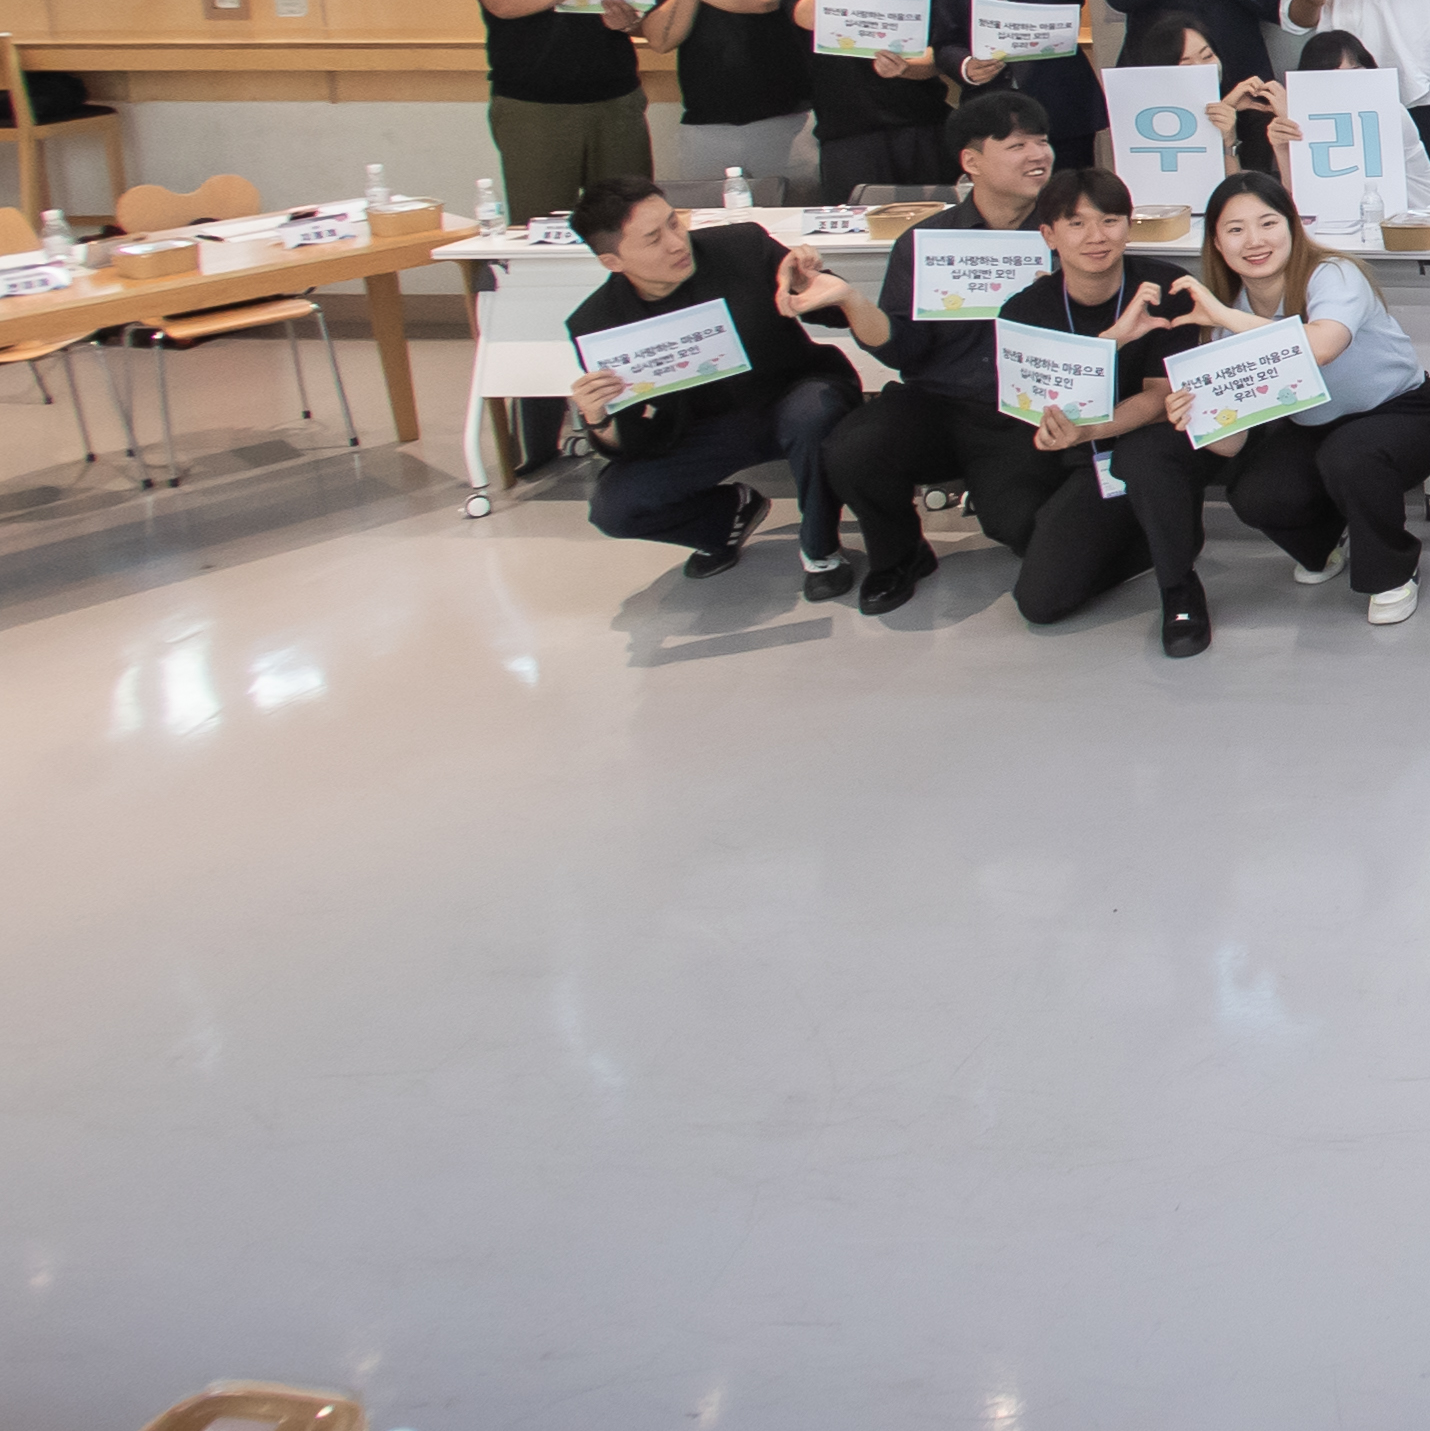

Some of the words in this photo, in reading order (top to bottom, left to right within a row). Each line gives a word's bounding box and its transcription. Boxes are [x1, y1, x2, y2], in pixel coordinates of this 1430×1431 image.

[1130, 106, 1207, 172] 우
[1308, 110, 1383, 178] 리
[926, 256, 954, 266] 청년을
[959, 256, 998, 266] 사랑하는
[1003, 256, 1042, 266] 마음으로
[952, 269, 991, 279] 십시일반
[995, 269, 1015, 279] 모인
[968, 283, 988, 292] 우리
[635, 342, 678, 358] 사랑하는
[681, 325, 726, 343] 마음으로
[1003, 348, 1023, 363] 청년을
[1027, 356, 1060, 372] 사랑하는
[1061, 363, 1104, 377] 마음으로
[1216, 362, 1257, 379] 사랑하는
[1259, 346, 1302, 365] 마음으로
[1021, 367, 1051, 382] 십시일반
[1055, 374, 1073, 389] 모인
[1213, 376, 1254, 396] 십시일반
[1257, 367, 1278, 382] 모인
[1033, 386, 1047, 398] 우리
[1235, 389, 1256, 402] 우리
